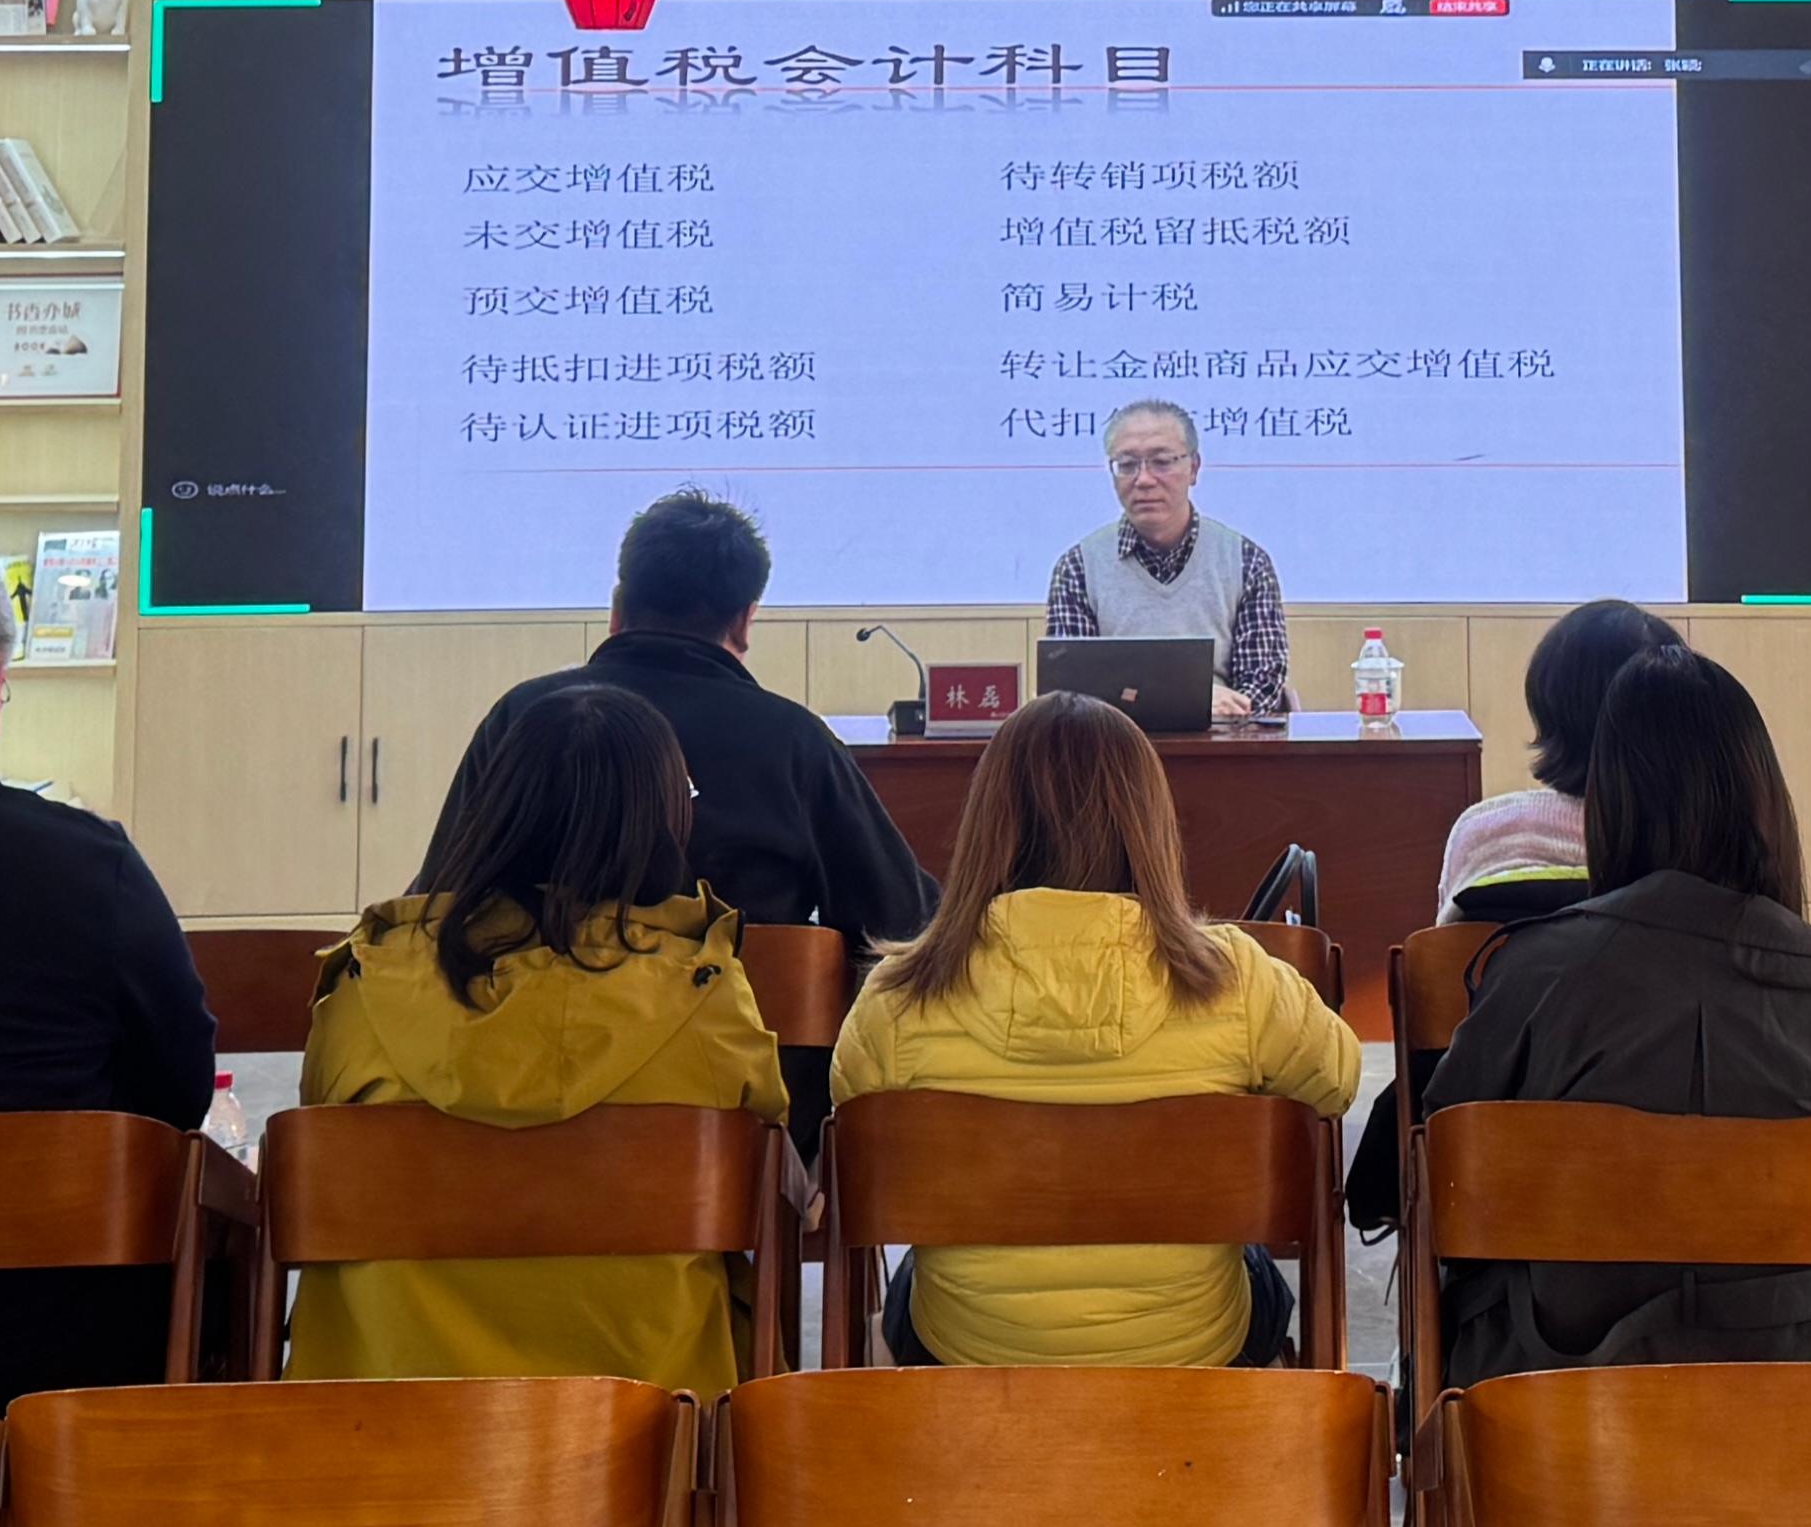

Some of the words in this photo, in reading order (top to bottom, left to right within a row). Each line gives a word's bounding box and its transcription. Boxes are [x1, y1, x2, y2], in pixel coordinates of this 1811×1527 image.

[436, 43, 1171, 87] 增值税会计科目
[464, 162, 715, 194] 应交增值税
[1001, 160, 1300, 191] 待转销项税额
[464, 219, 715, 250] 未交增值税
[1000, 216, 1351, 247] 增值税留抵税额
[465, 284, 715, 316] 预交增值税
[1001, 282, 1199, 313] 简易计税
[462, 351, 817, 384] 待抵扣进项税额
[1000, 348, 1556, 380] 转让金融商品应交增值税
[461, 408, 816, 443] 待认证进项税额
[1000, 406, 1353, 438] 代扣增值税
[945, 683, 1001, 710] 林磊
